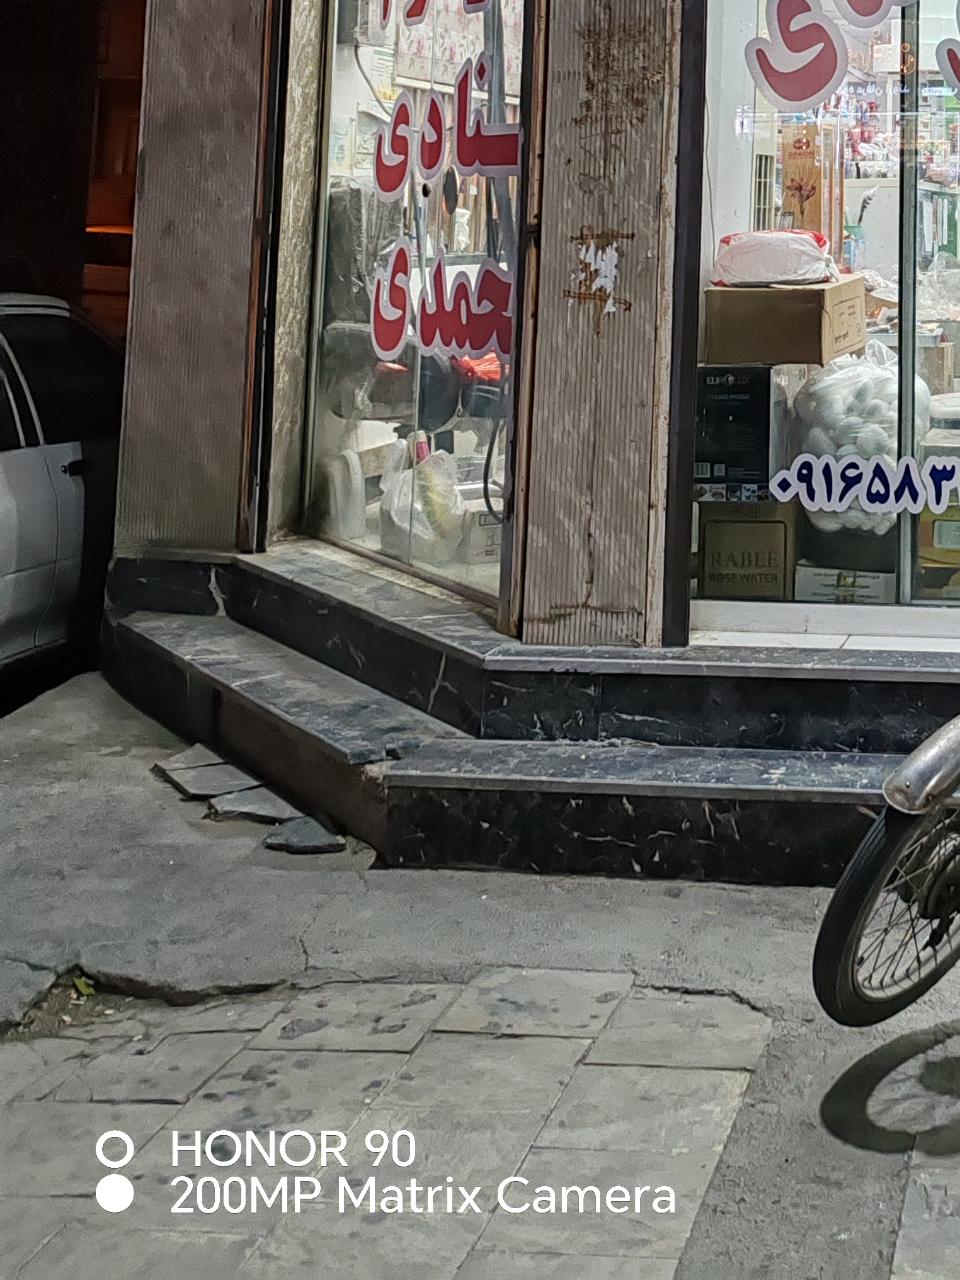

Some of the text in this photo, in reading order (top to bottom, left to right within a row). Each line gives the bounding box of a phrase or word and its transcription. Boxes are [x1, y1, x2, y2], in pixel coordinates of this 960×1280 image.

[374, 56, 520, 194] نادی
[372, 245, 514, 357] حمدی
[711, 551, 779, 568] RABEE
